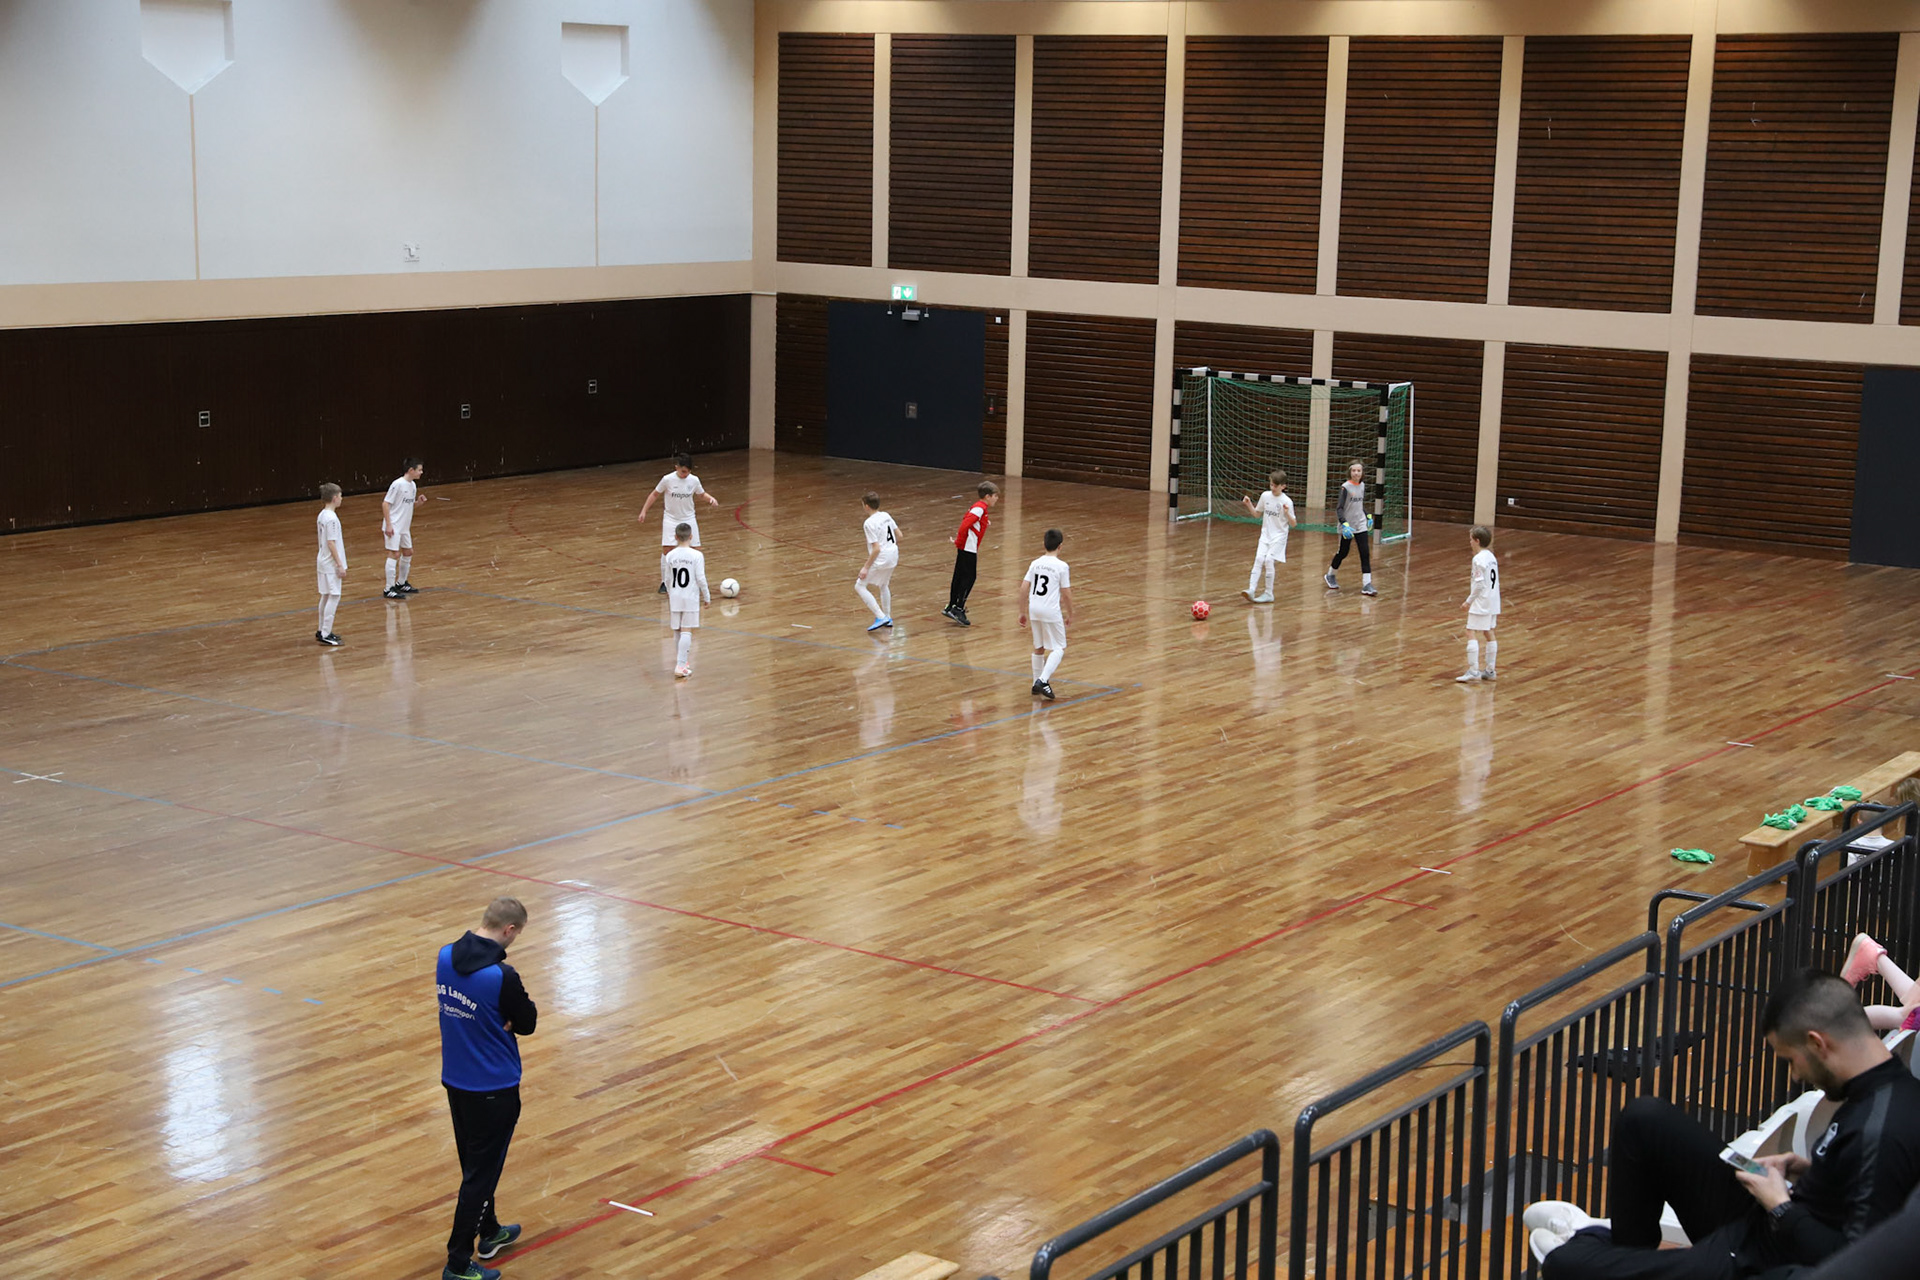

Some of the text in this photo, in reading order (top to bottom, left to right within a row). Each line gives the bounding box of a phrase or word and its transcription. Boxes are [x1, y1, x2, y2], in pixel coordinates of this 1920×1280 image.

[886, 525, 895, 544] 4
[672, 567, 690, 589] 10
[1032, 573, 1050, 597] 13
[1490, 568, 1496, 590] 9
[448, 985, 478, 1011] Langen
